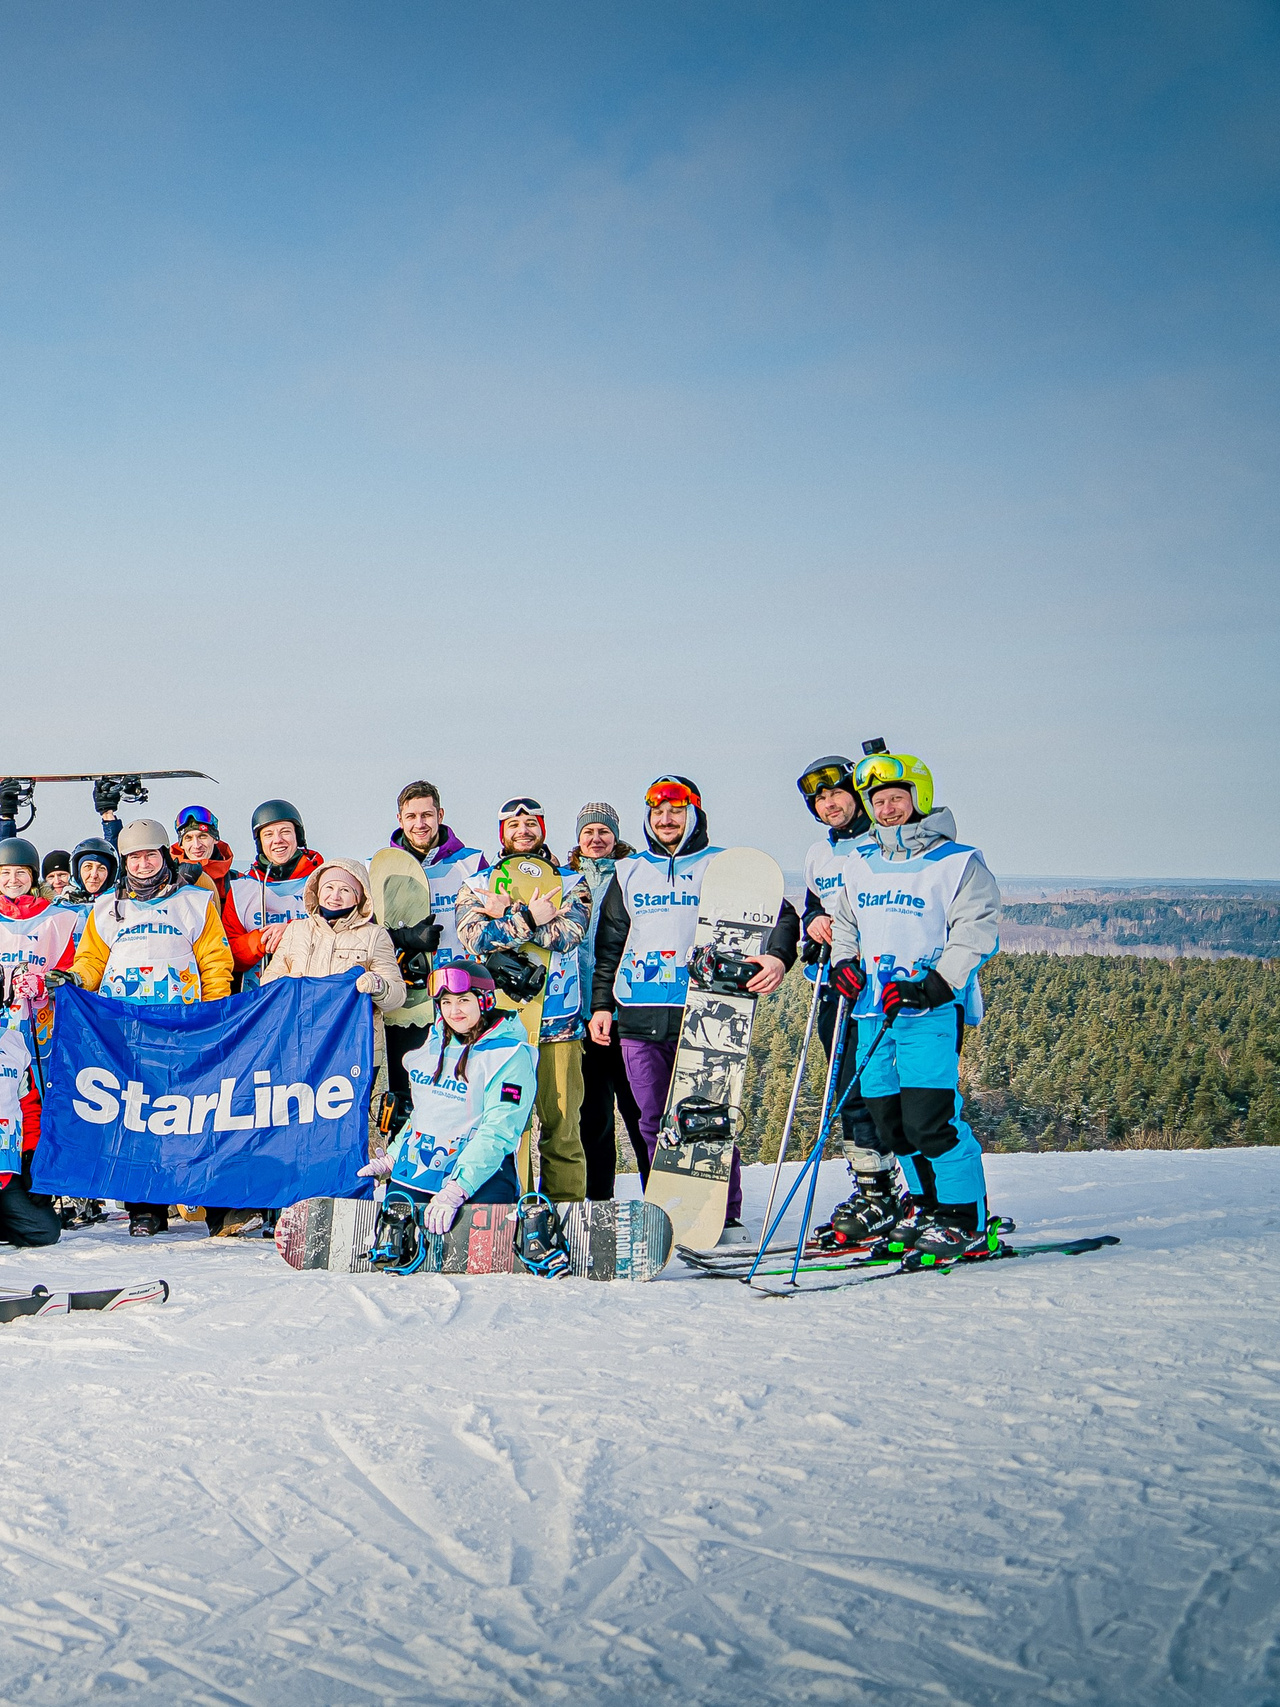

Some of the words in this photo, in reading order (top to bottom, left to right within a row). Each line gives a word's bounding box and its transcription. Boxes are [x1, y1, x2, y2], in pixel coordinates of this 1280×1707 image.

[815, 873, 845, 891] StarL
[633, 891, 699, 907] StarLin
[857, 890, 926, 909] StarLine
[253, 910, 309, 925] StarLin
[409, 1069, 468, 1094] StarLine
[72, 1067, 355, 1136] StarLine
[867, 1215, 894, 1233] HEAD
[964, 1235, 986, 1252] TECNICA
